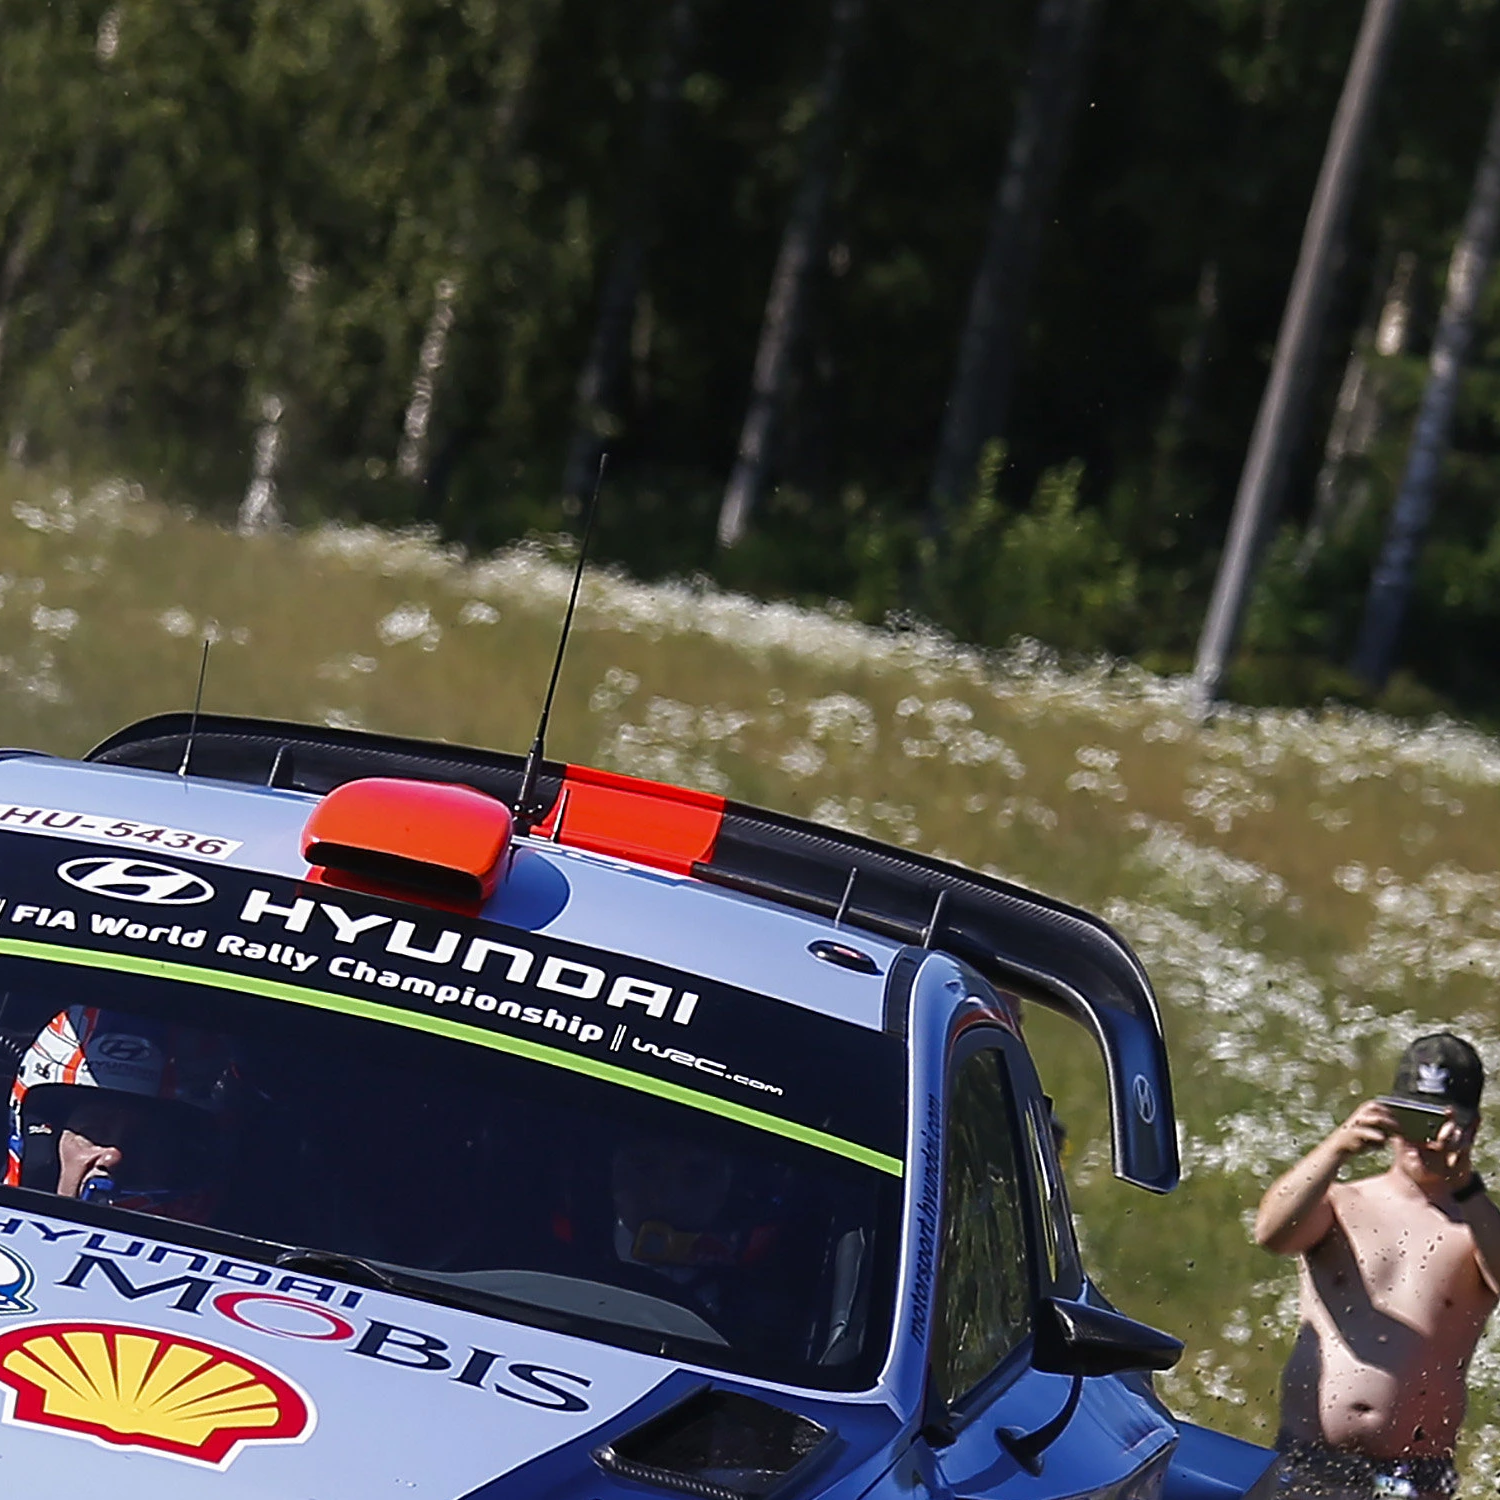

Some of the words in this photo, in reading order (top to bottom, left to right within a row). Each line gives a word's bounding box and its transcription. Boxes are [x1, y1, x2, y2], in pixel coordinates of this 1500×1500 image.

[10, 904, 77, 931] FIA
[90, 913, 208, 949] World
[216, 934, 320, 973] Rally
[328, 956, 604, 1043] Championship
[239, 888, 700, 1026] HYUNDAI
[55, 1251, 594, 1413] MOBIS
